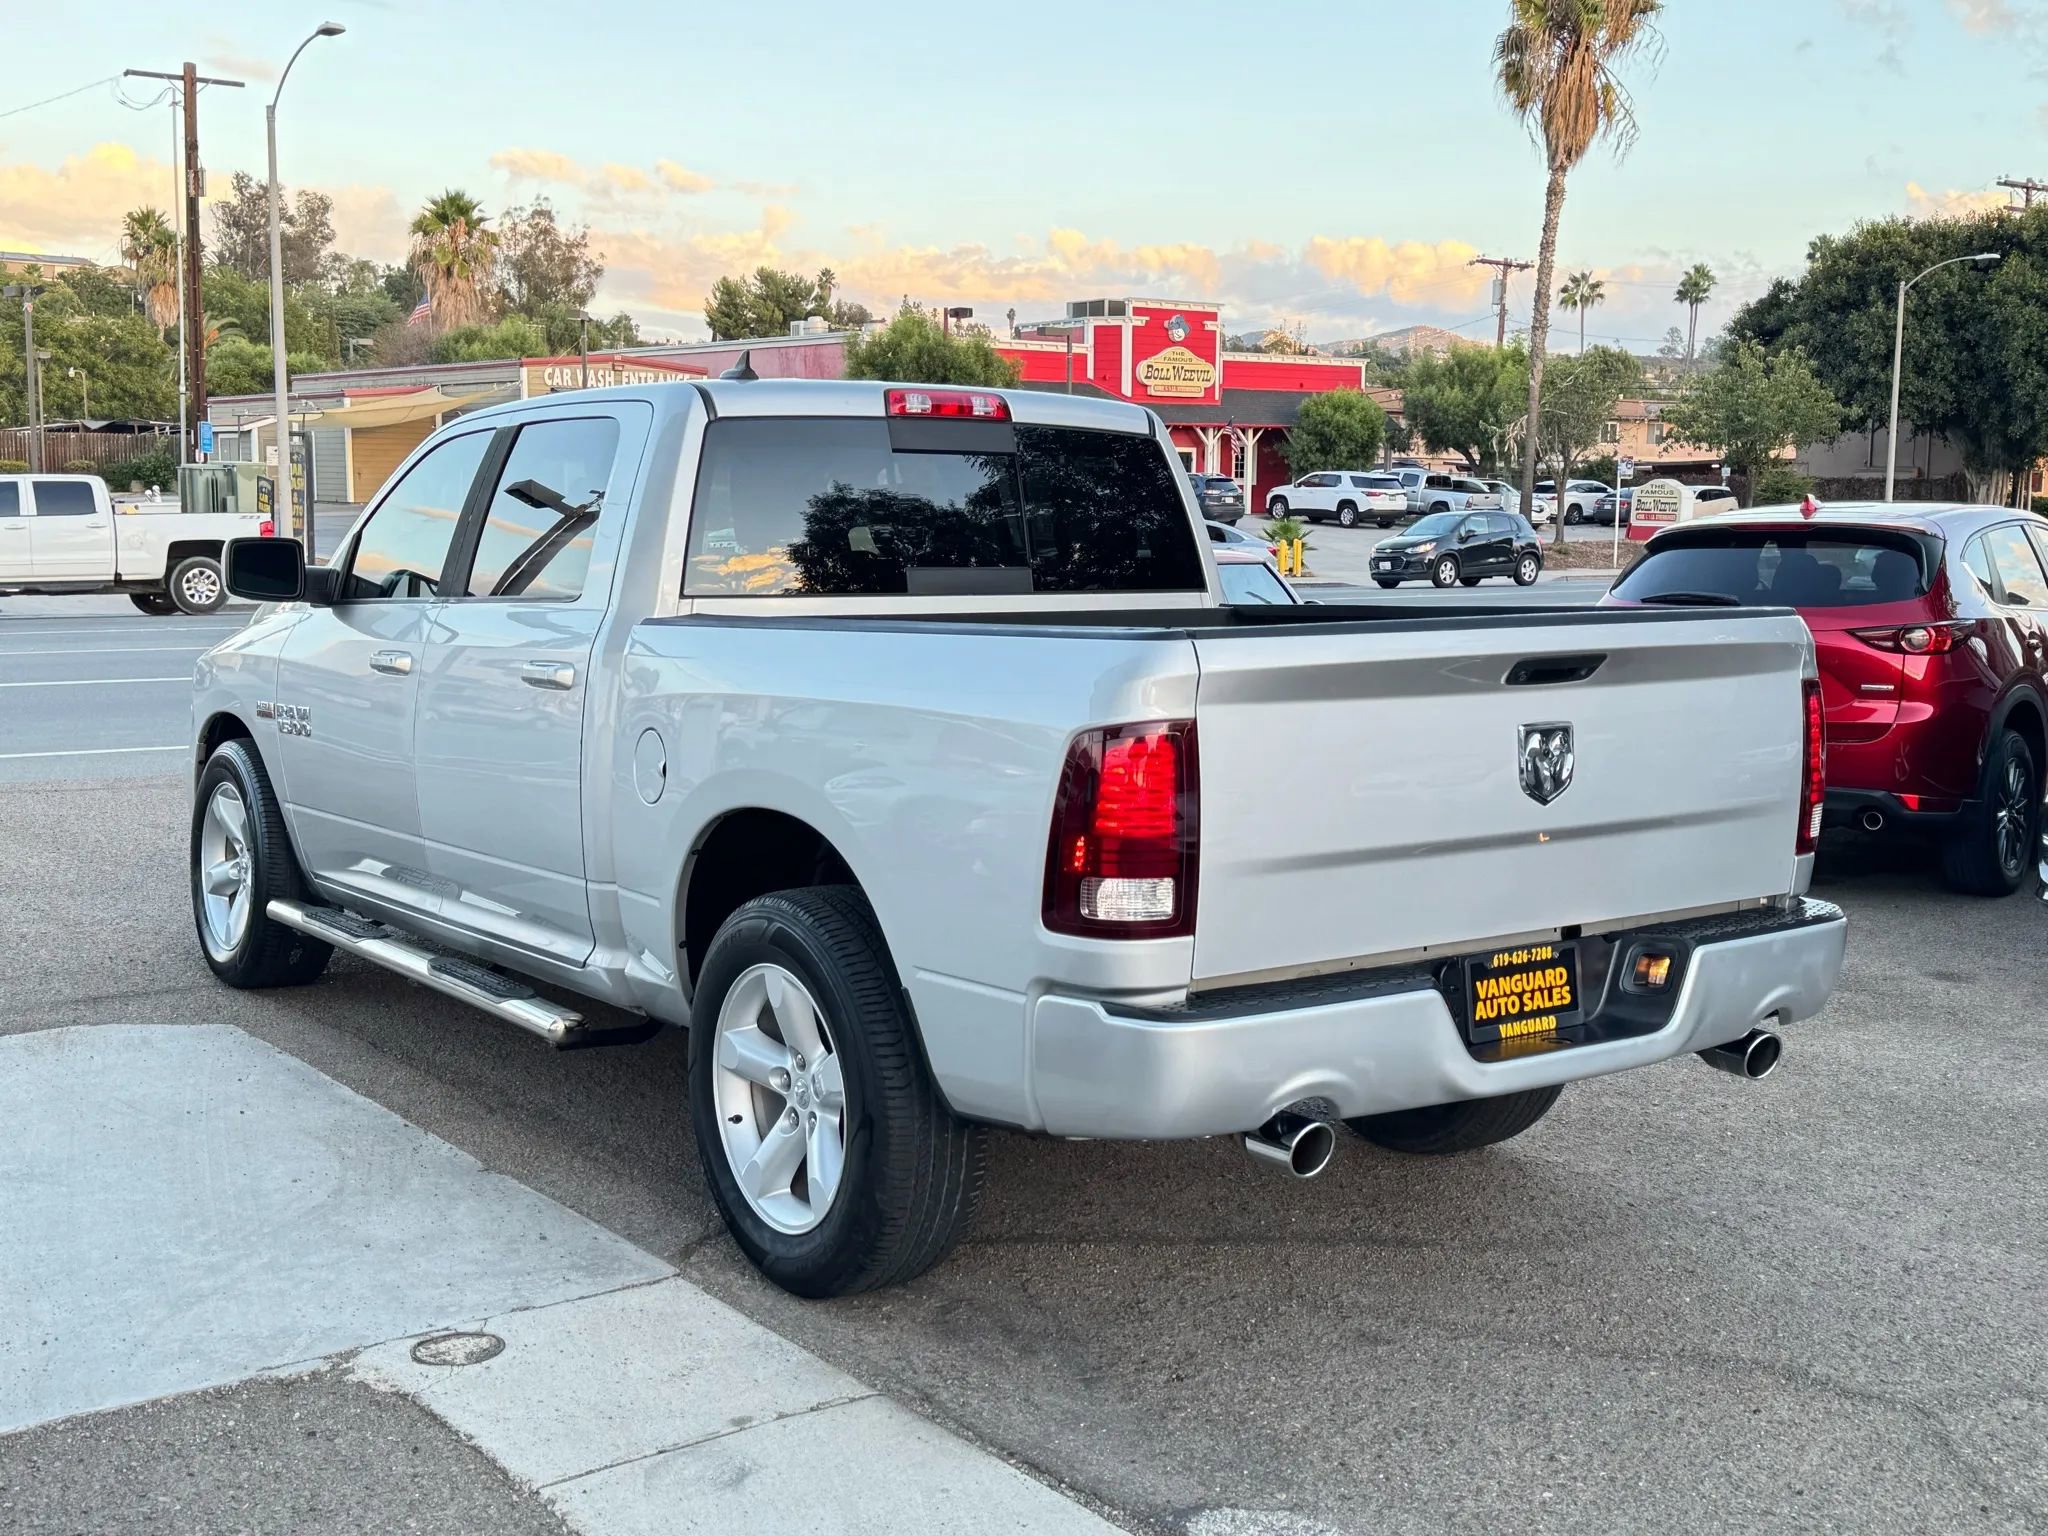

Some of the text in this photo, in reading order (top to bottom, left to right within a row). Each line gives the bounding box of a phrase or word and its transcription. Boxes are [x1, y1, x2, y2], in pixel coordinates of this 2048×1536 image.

[543, 367, 572, 386] CAR
[576, 368, 615, 387] WASH
[1144, 364, 1212, 382] BOLL WEEVIL
[1635, 498, 1679, 513] BOLL WEEVIL
[277, 703, 312, 721] RAM
[278, 718, 312, 737] 1500
[1493, 946, 1552, 967] 619-626-7288
[1475, 966, 1567, 999] VANGUARD
[1475, 985, 1571, 1020] AUTO SALES
[1499, 1015, 1556, 1038] VANGUARD
